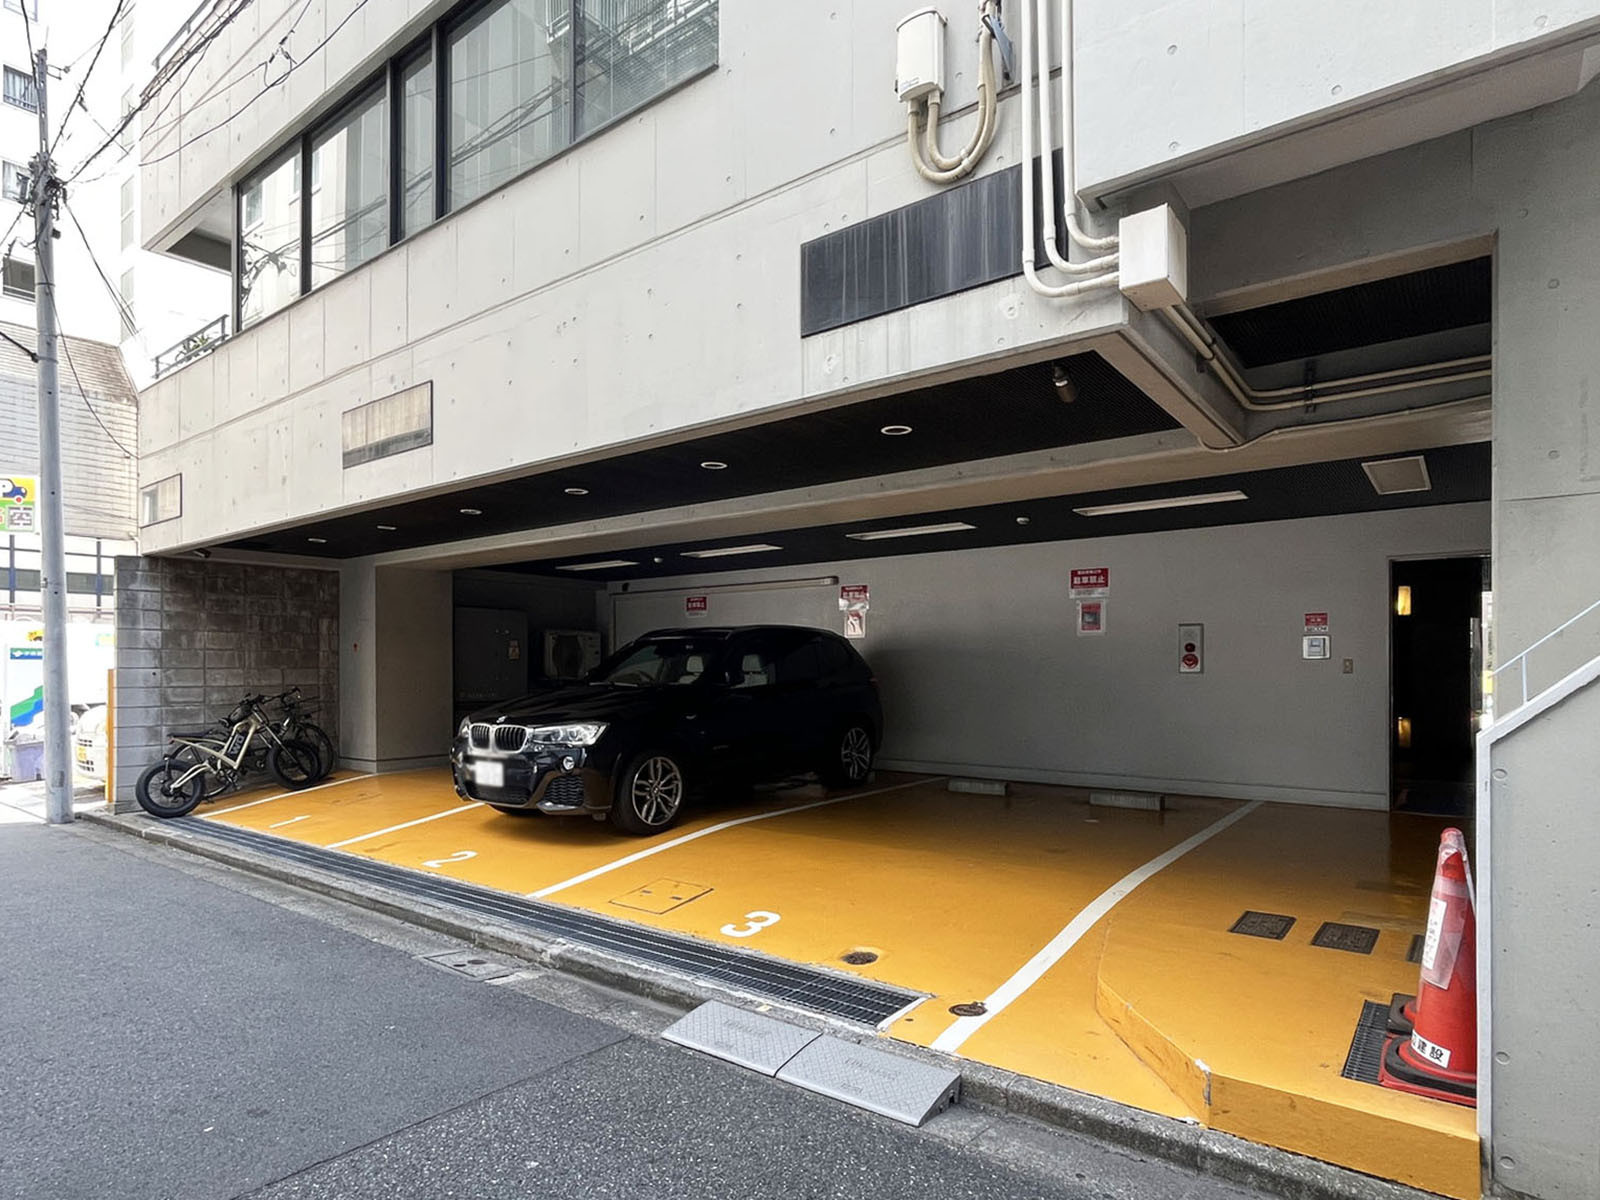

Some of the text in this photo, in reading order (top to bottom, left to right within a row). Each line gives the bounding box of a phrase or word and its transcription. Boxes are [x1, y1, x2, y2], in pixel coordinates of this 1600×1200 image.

[269, 815, 311, 829] 1
[422, 850, 478, 869] 2
[720, 911, 781, 938] 3
